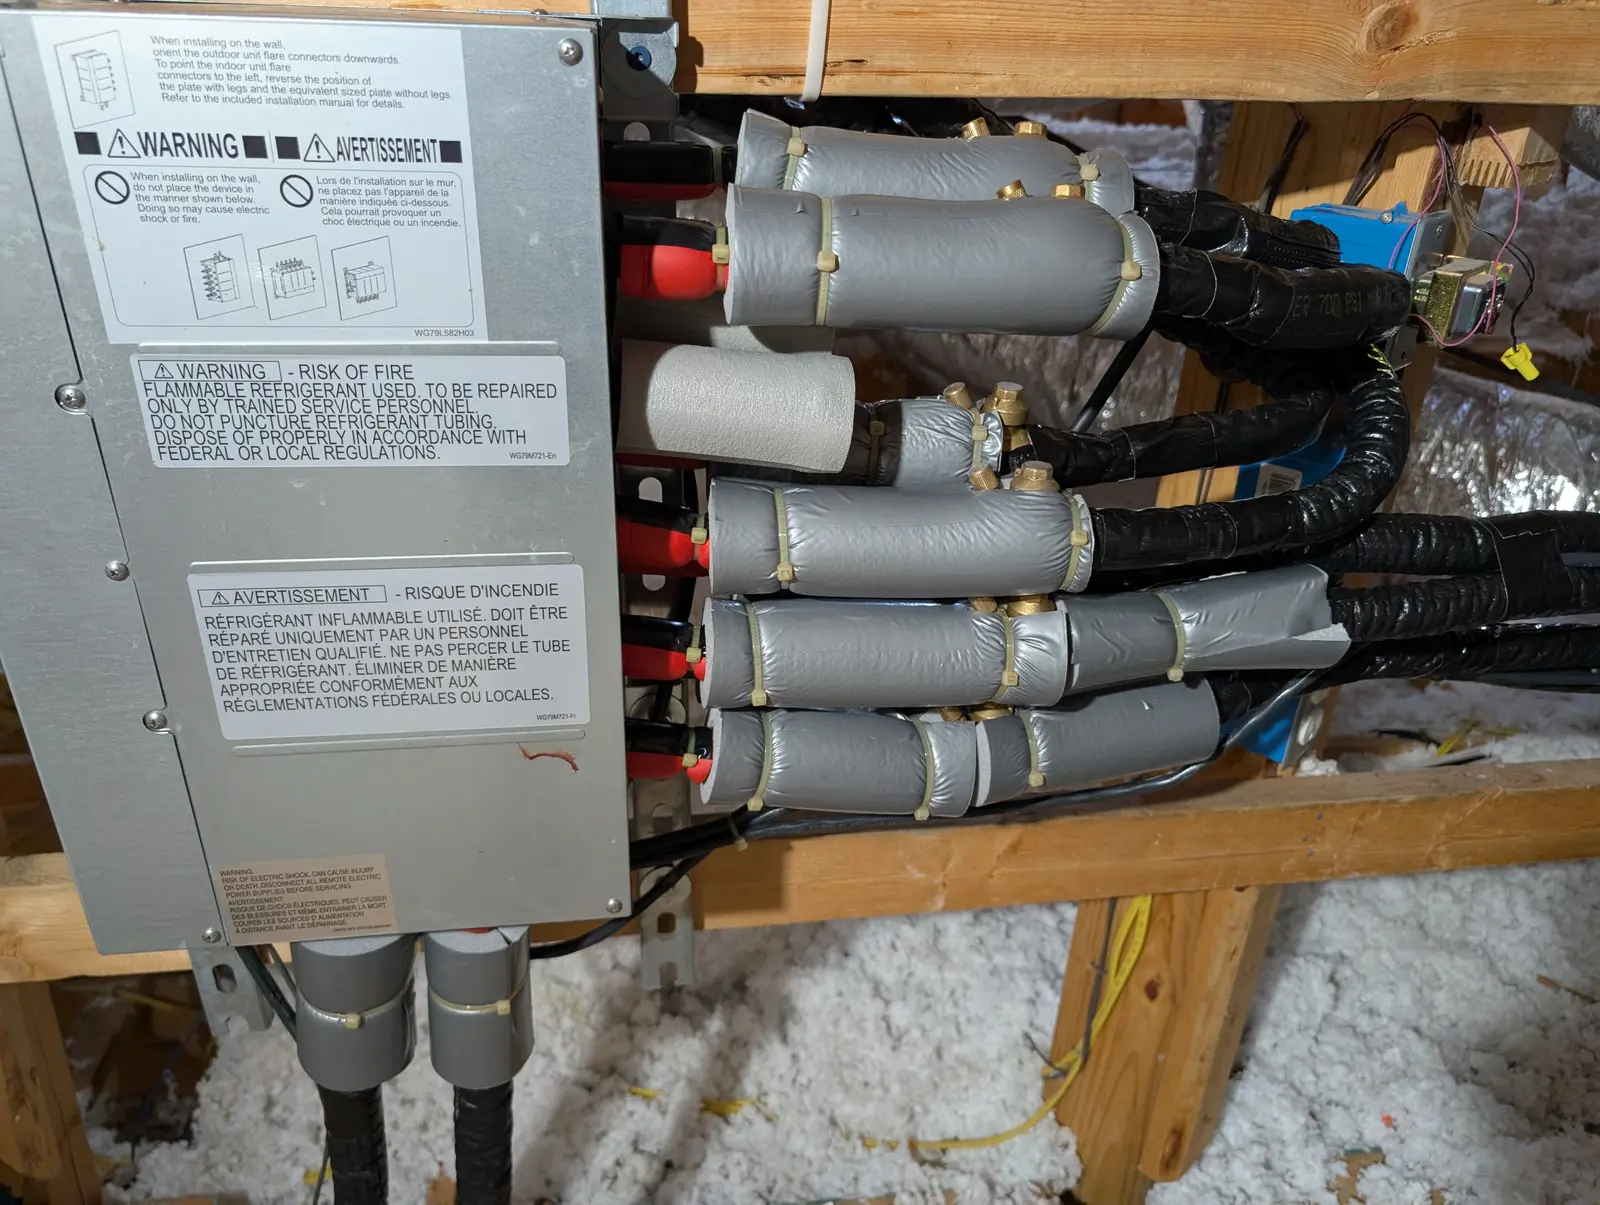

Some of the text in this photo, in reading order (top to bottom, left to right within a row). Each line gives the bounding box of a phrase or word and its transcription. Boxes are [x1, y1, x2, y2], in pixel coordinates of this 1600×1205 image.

[150, 36, 286, 50] When installing on the wall,
[153, 48, 401, 64] orient the outdoor unit flare connectors downwards.
[155, 59, 291, 71] To point the indoor unit flare
[162, 93, 405, 108] Refer to the included installation manual for details.
[137, 131, 239, 159] WARNING
[337, 136, 437, 164] AVERTISSEMENT
[130, 172, 160, 181] When
[161, 173, 204, 184] installing
[220, 174, 237, 183] the
[237, 174, 261, 184] wall,
[316, 176, 337, 185] Lors
[338, 177, 352, 185] de
[352, 177, 407, 186] l'installation
[425, 178, 434, 187] le
[435, 180, 456, 188] mur,
[133, 183, 254, 194] do not place the device in
[331, 187, 363, 197] placez
[363, 189, 382, 198] pas
[383, 187, 425, 198] l'appareil
[425, 188, 439, 197] de
[440, 188, 449, 197] la
[138, 204, 166, 215] Doing
[181, 206, 203, 215] may
[235, 205, 270, 214] electric
[320, 197, 451, 208] manière indiquée ci-dessous.
[140, 214, 168, 223] shock
[181, 215, 201, 223] fire.
[322, 217, 345, 226] choc
[346, 217, 391, 228] électrique
[420, 218, 461, 227] incendie.
[176, 364, 266, 380] WARNING
[299, 364, 414, 380] RISK OF FIRE
[144, 382, 557, 398] FLAMMABLE REFRIGERANT USED. TO BE REPAIRED
[148, 399, 479, 414] ONLY BY TRAINED SERVICE PERSONNEL.
[151, 414, 497, 430] DO NOT PUNCTURE REFRIGERANT TUBING.
[154, 429, 527, 445] DISPOSE OF PROPERLY IN ACCORDANCE WITH
[158, 445, 440, 460] FEDERAL OR LOCAL REGULATIONS.
[233, 587, 369, 604] AVERTISSEMENT
[405, 583, 559, 601] RISQUE D'INCENDIE
[204, 603, 568, 629] RÉFRIGÉRANT INFLAMMABLE UTILISÉ. DOIT ÊTRE
[208, 624, 528, 647] RÉPARÉ UNIQUEMENT PAR UN PERSONNEL
[212, 639, 571, 664] D'ENTRETIEN QUALIFIÉ. NE PAS PERCER LE TUBE
[216, 654, 516, 680] DE RÉFRIGÉRANT. ÉLIMINER DE MANIÈRE
[220, 673, 478, 697] APPROPRIÉE CONFORMÉMENT AUX
[223, 688, 554, 712] RÉGLEMENTATIONS FÉDÉRALES OU LOCALES.
